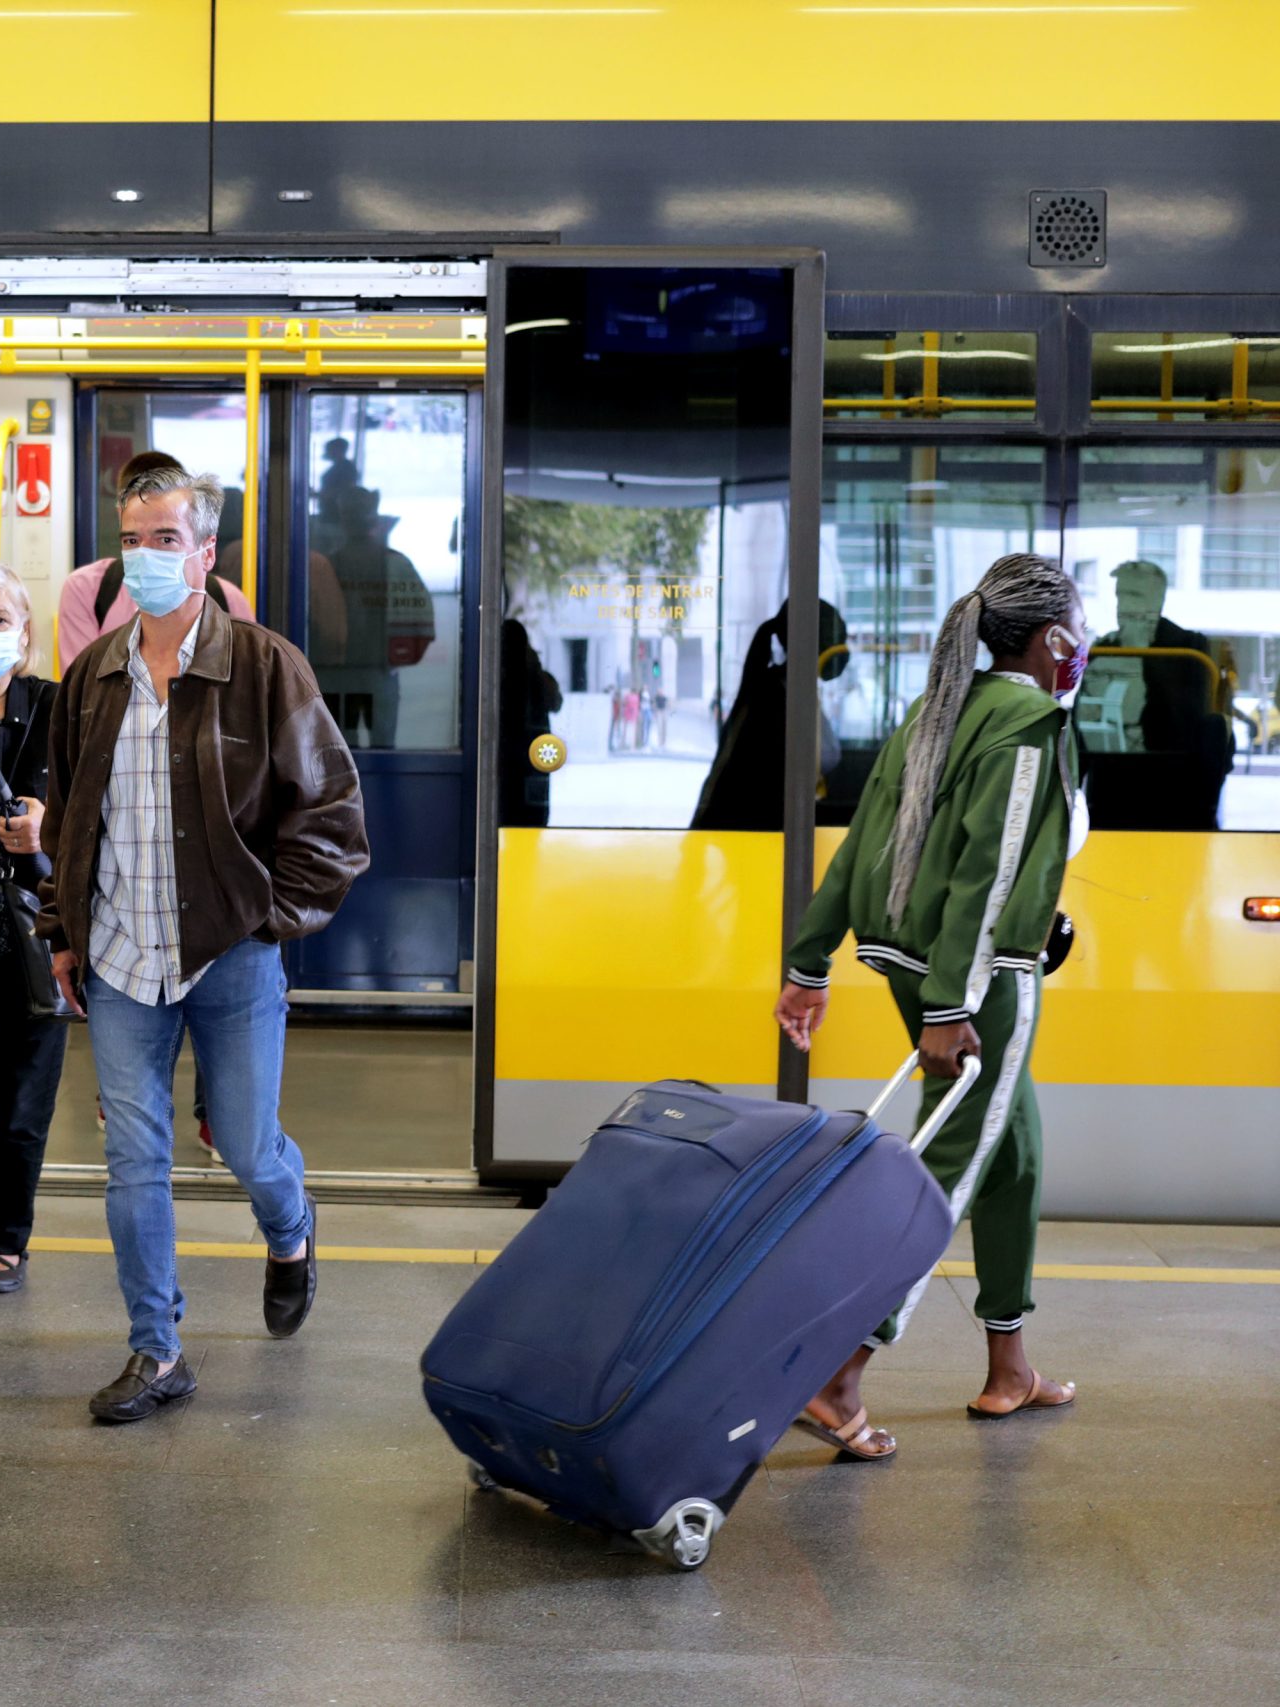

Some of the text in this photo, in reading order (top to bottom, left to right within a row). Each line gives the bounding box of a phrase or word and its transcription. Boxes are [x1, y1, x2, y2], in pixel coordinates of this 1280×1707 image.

[568, 585, 715, 599] ANTES DE ENTRAR
[597, 605, 642, 619] DEIXE
